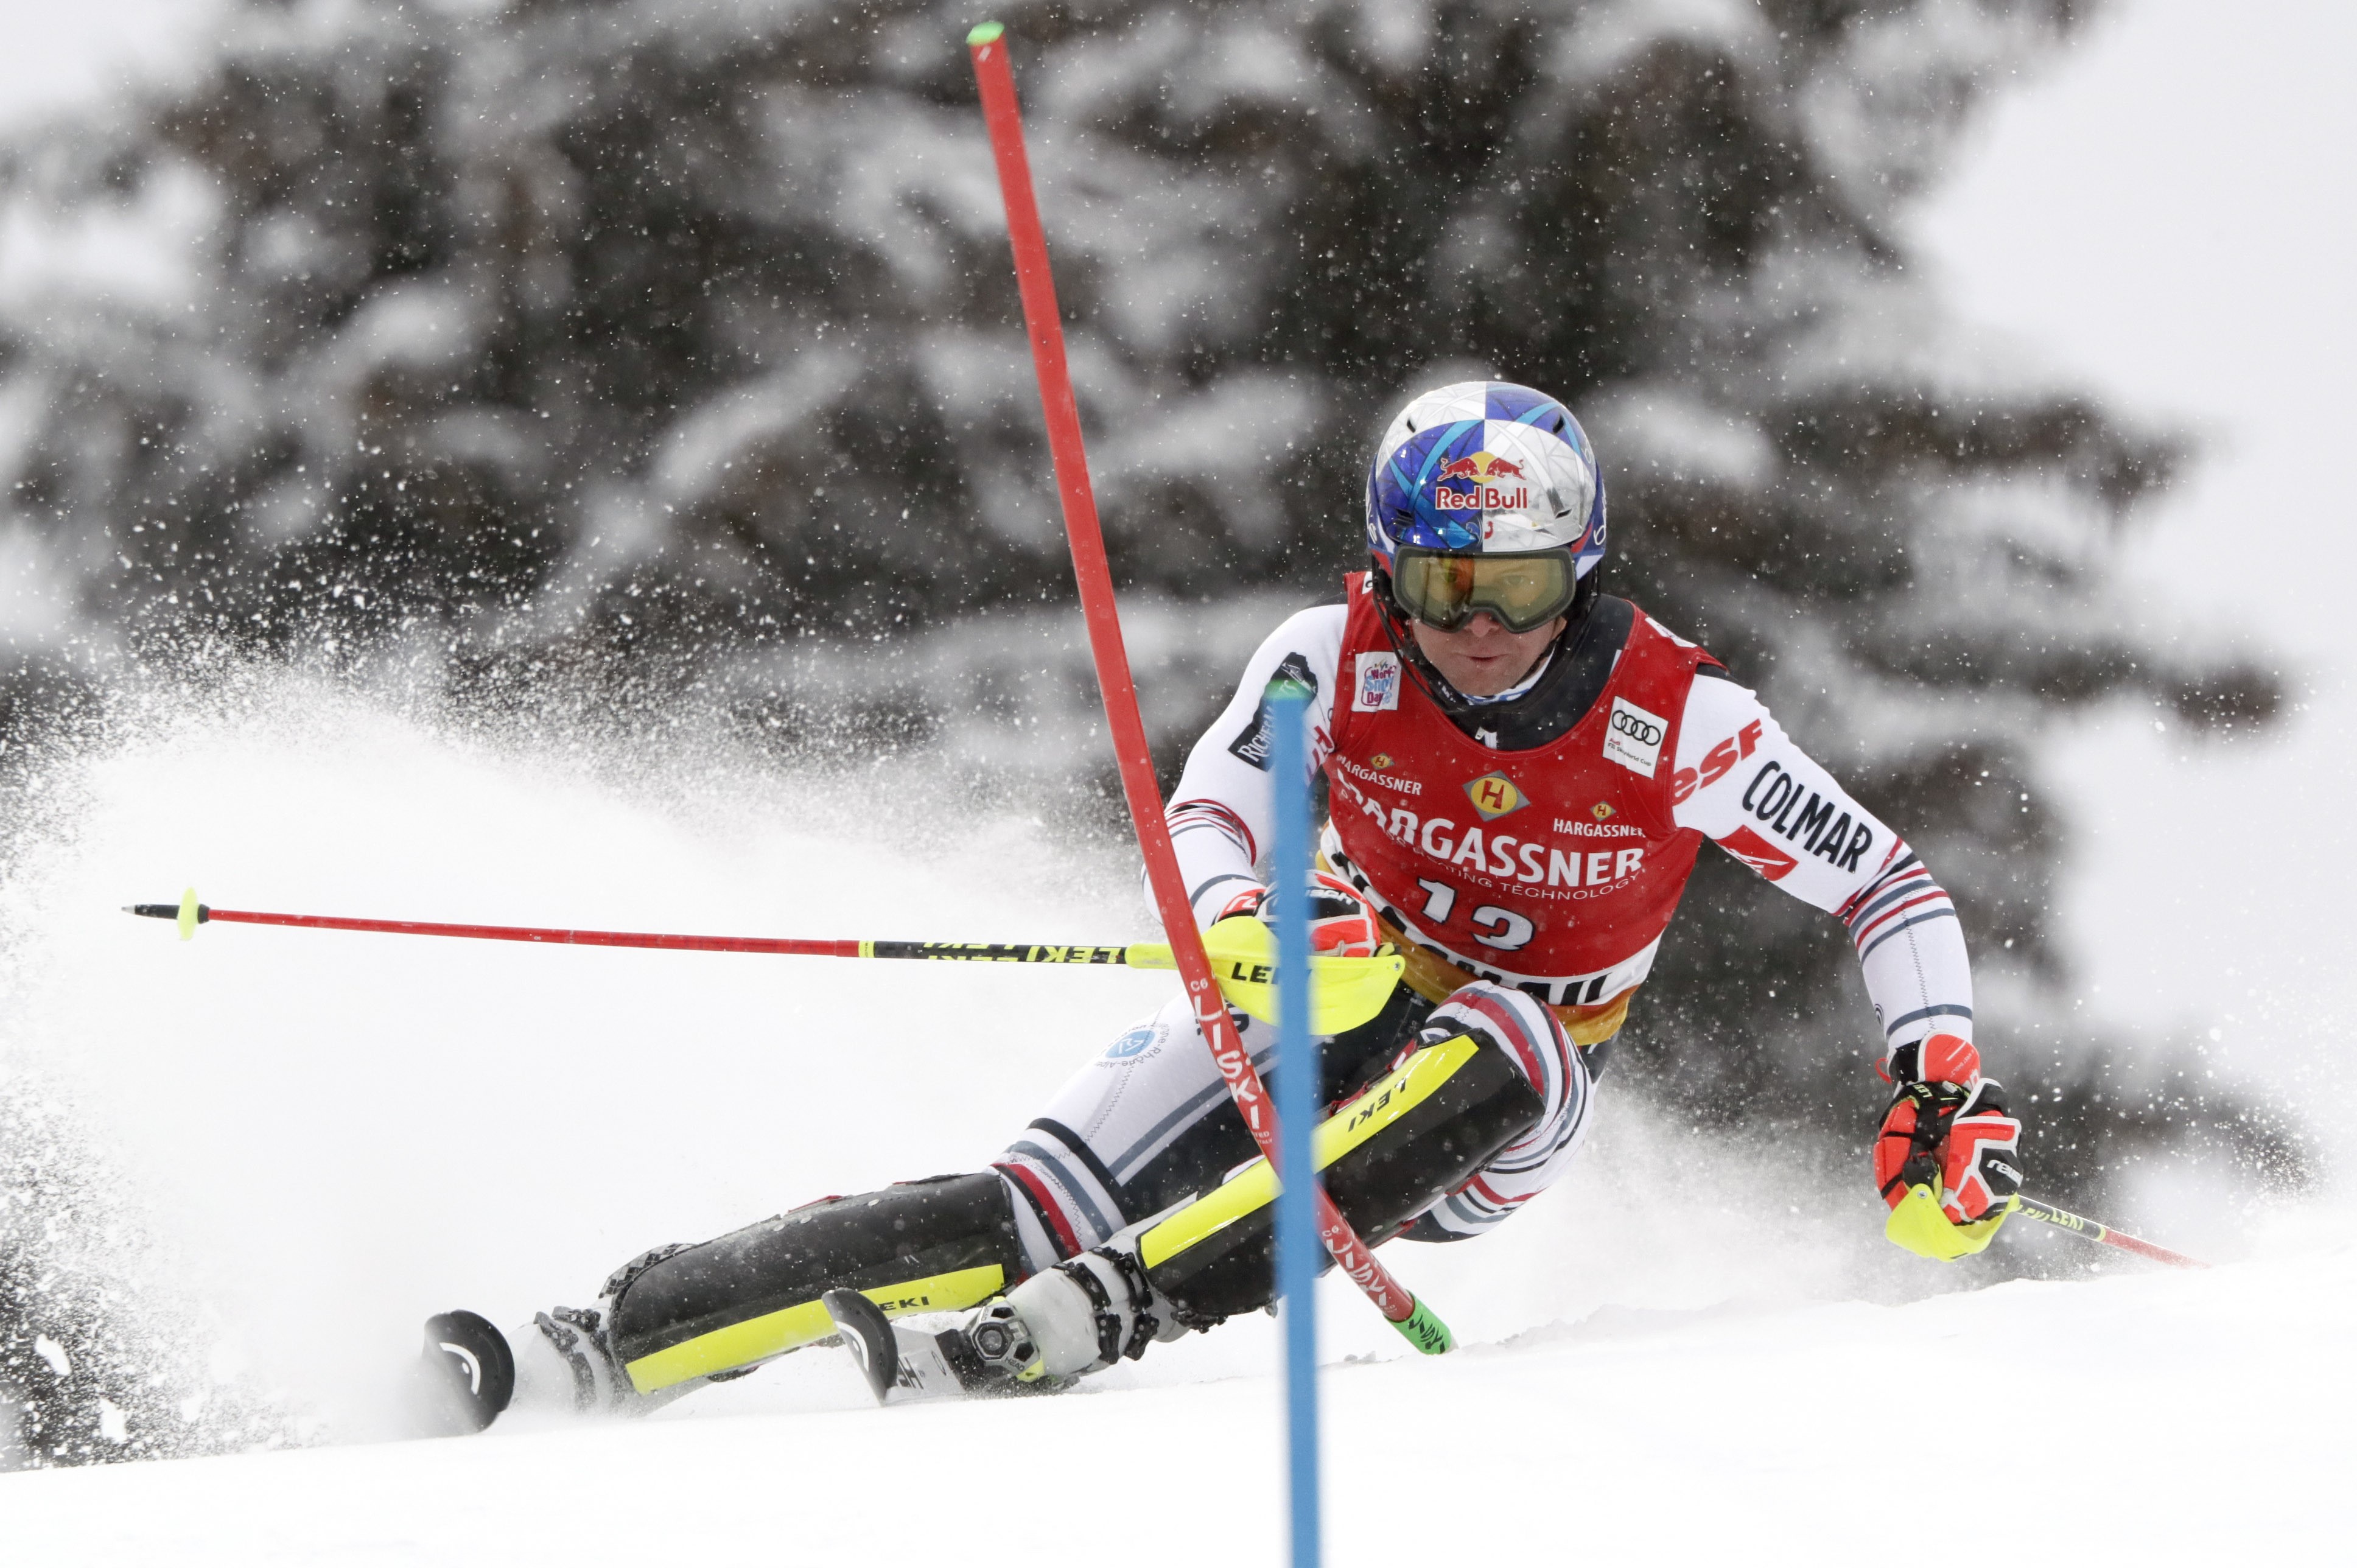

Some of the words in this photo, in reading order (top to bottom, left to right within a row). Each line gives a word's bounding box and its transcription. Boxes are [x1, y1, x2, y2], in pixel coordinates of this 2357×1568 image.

[1435, 486, 1482, 509] Red
[1485, 487, 1528, 509] Bull
[1742, 760, 1873, 873] COLMAR
[1499, 870, 1639, 900] TECHNOLOGY
[1026, 945, 1121, 964] LEKI
[1190, 978, 1208, 992] C6
[1194, 995, 1258, 1130] LISKI
[878, 1296, 930, 1311] EKI
